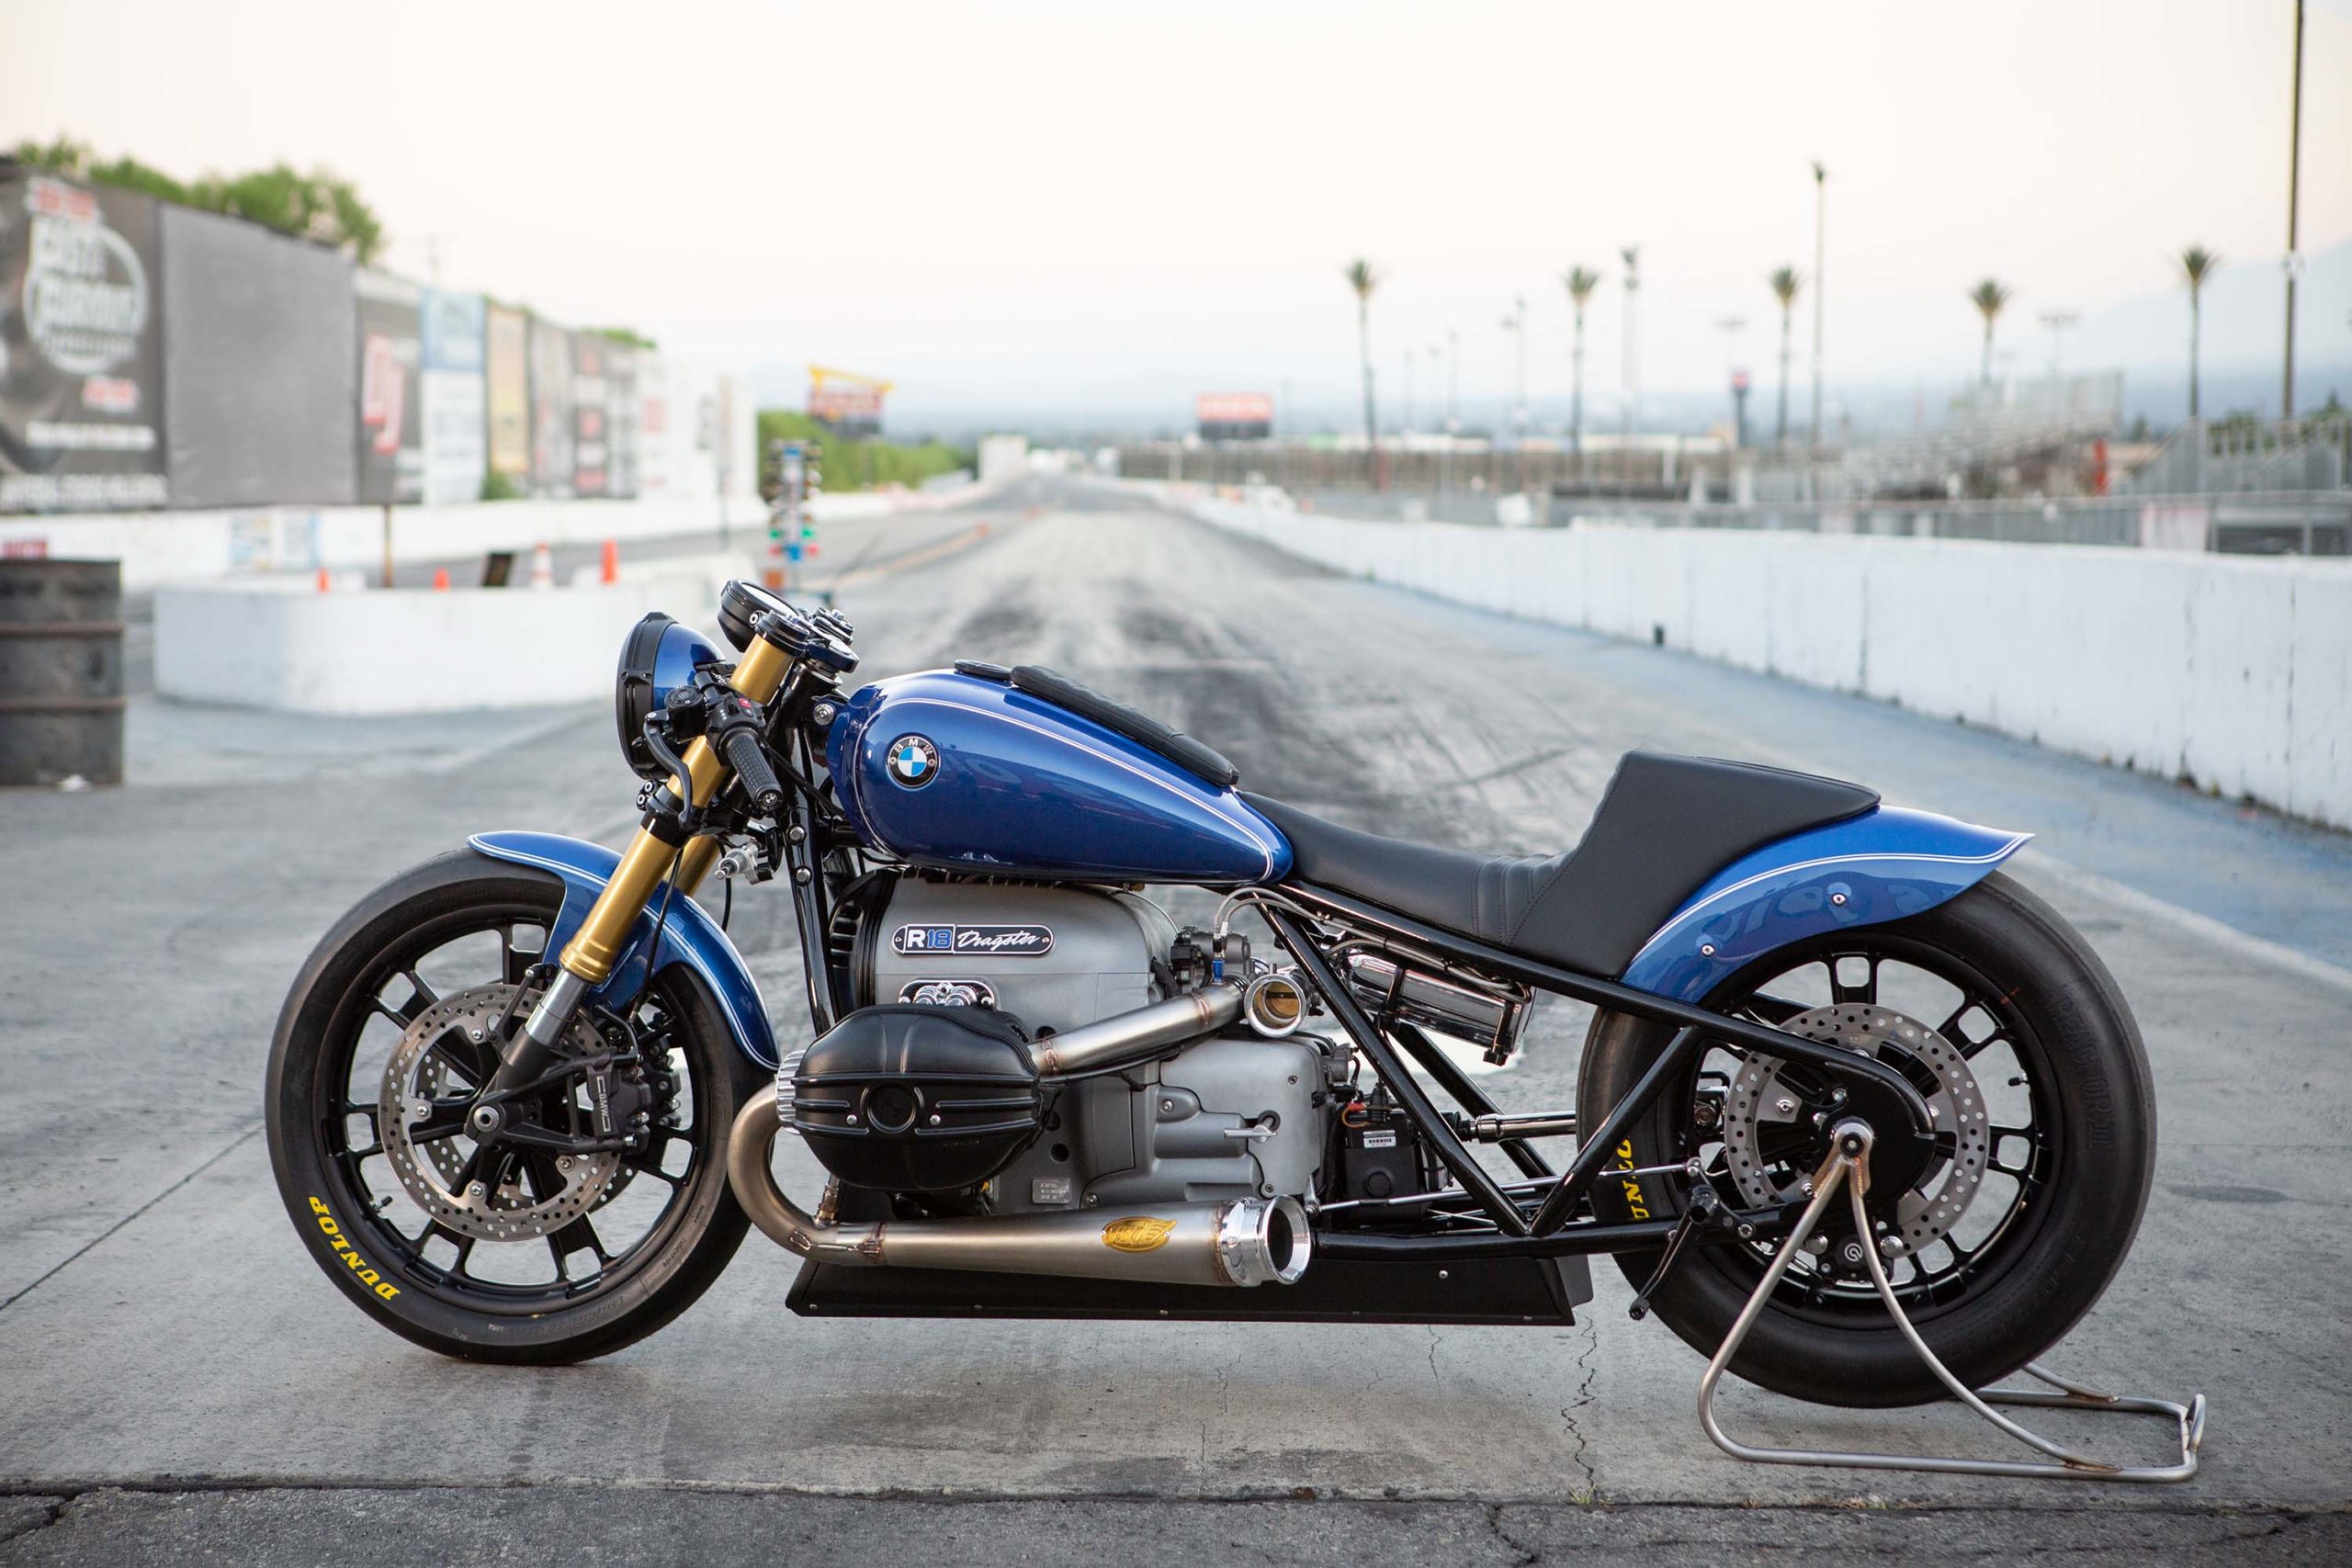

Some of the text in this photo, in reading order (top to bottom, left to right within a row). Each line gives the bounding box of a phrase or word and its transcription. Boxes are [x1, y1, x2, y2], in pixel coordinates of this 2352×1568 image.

[894, 738, 933, 755] BMW
[907, 929, 1041, 952] R18 Dragster
[598, 1093, 610, 1117] BMW
[1617, 1138, 1650, 1220] UNLO
[309, 1196, 401, 1301] DUNLOP
